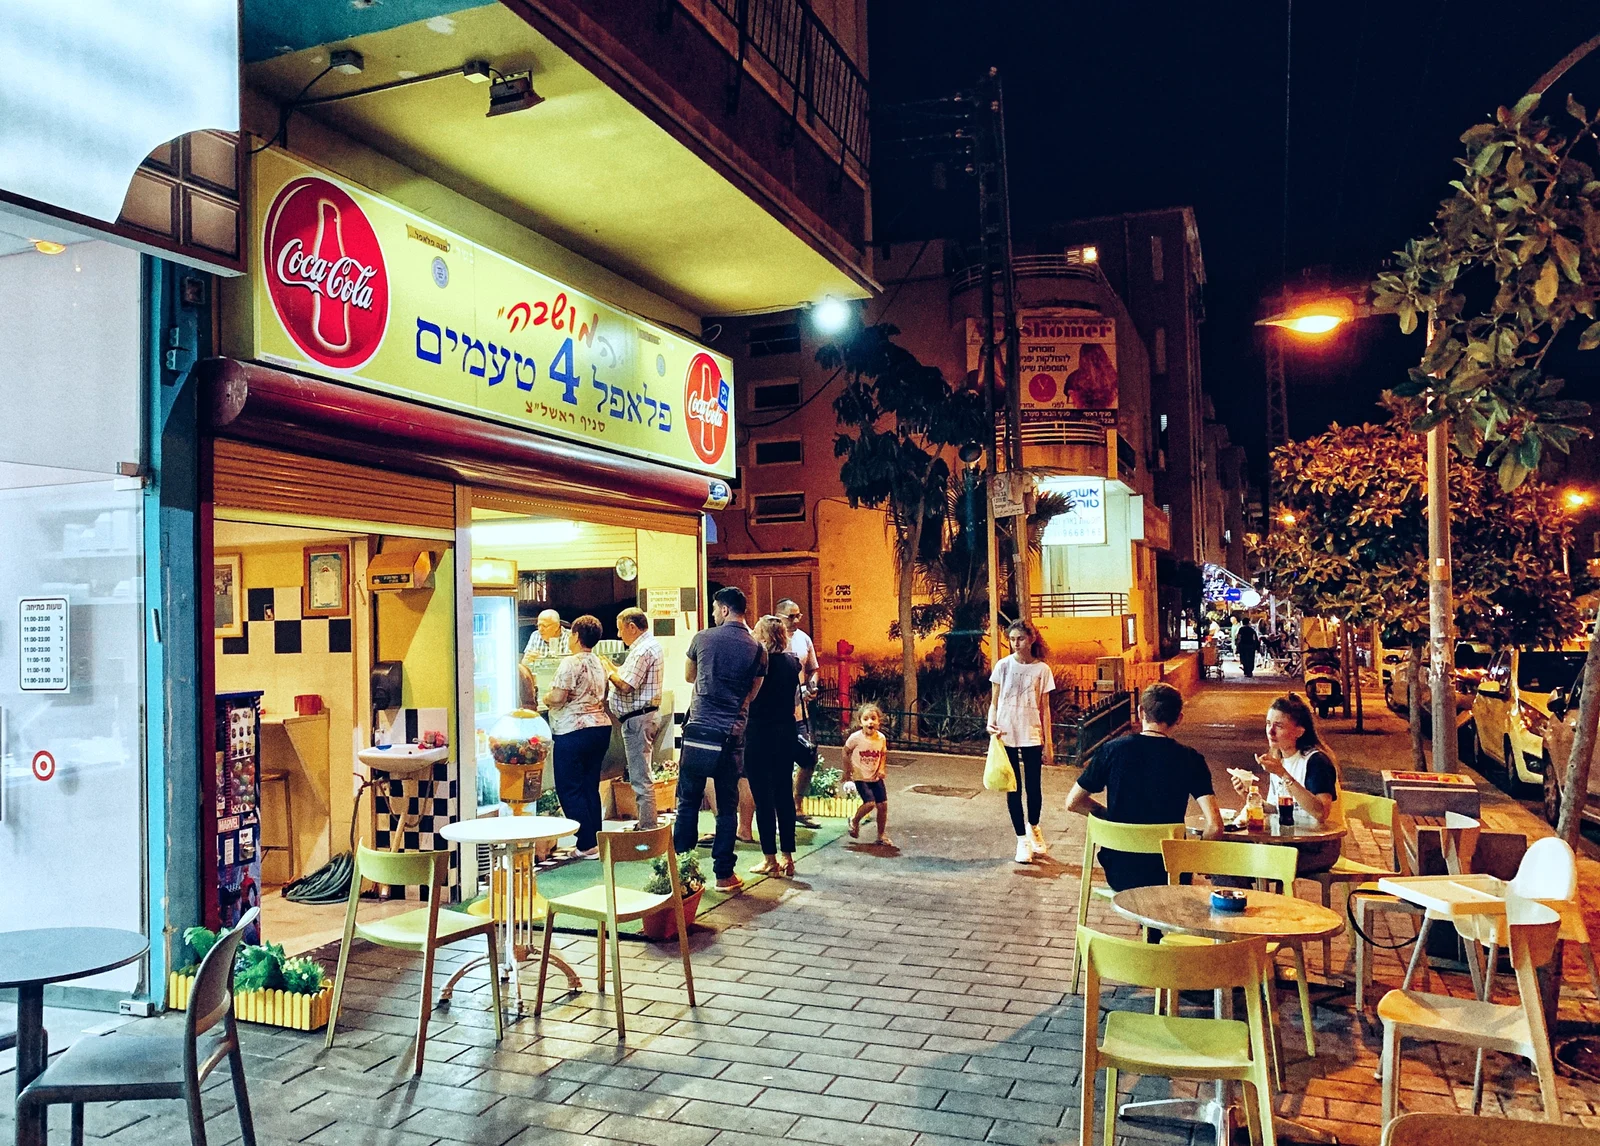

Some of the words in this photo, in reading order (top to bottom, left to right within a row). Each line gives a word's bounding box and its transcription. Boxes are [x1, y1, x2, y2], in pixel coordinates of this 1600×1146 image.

[277, 239, 377, 309] Coca-Cola
[416, 316, 536, 392] טעמים
[549, 337, 581, 406] 4
[580, 415, 606, 433] סניף
[592, 363, 672, 433] פלאפל
[46, 603, 63, 611] שעות
[219, 816, 239, 831] MARVEL
